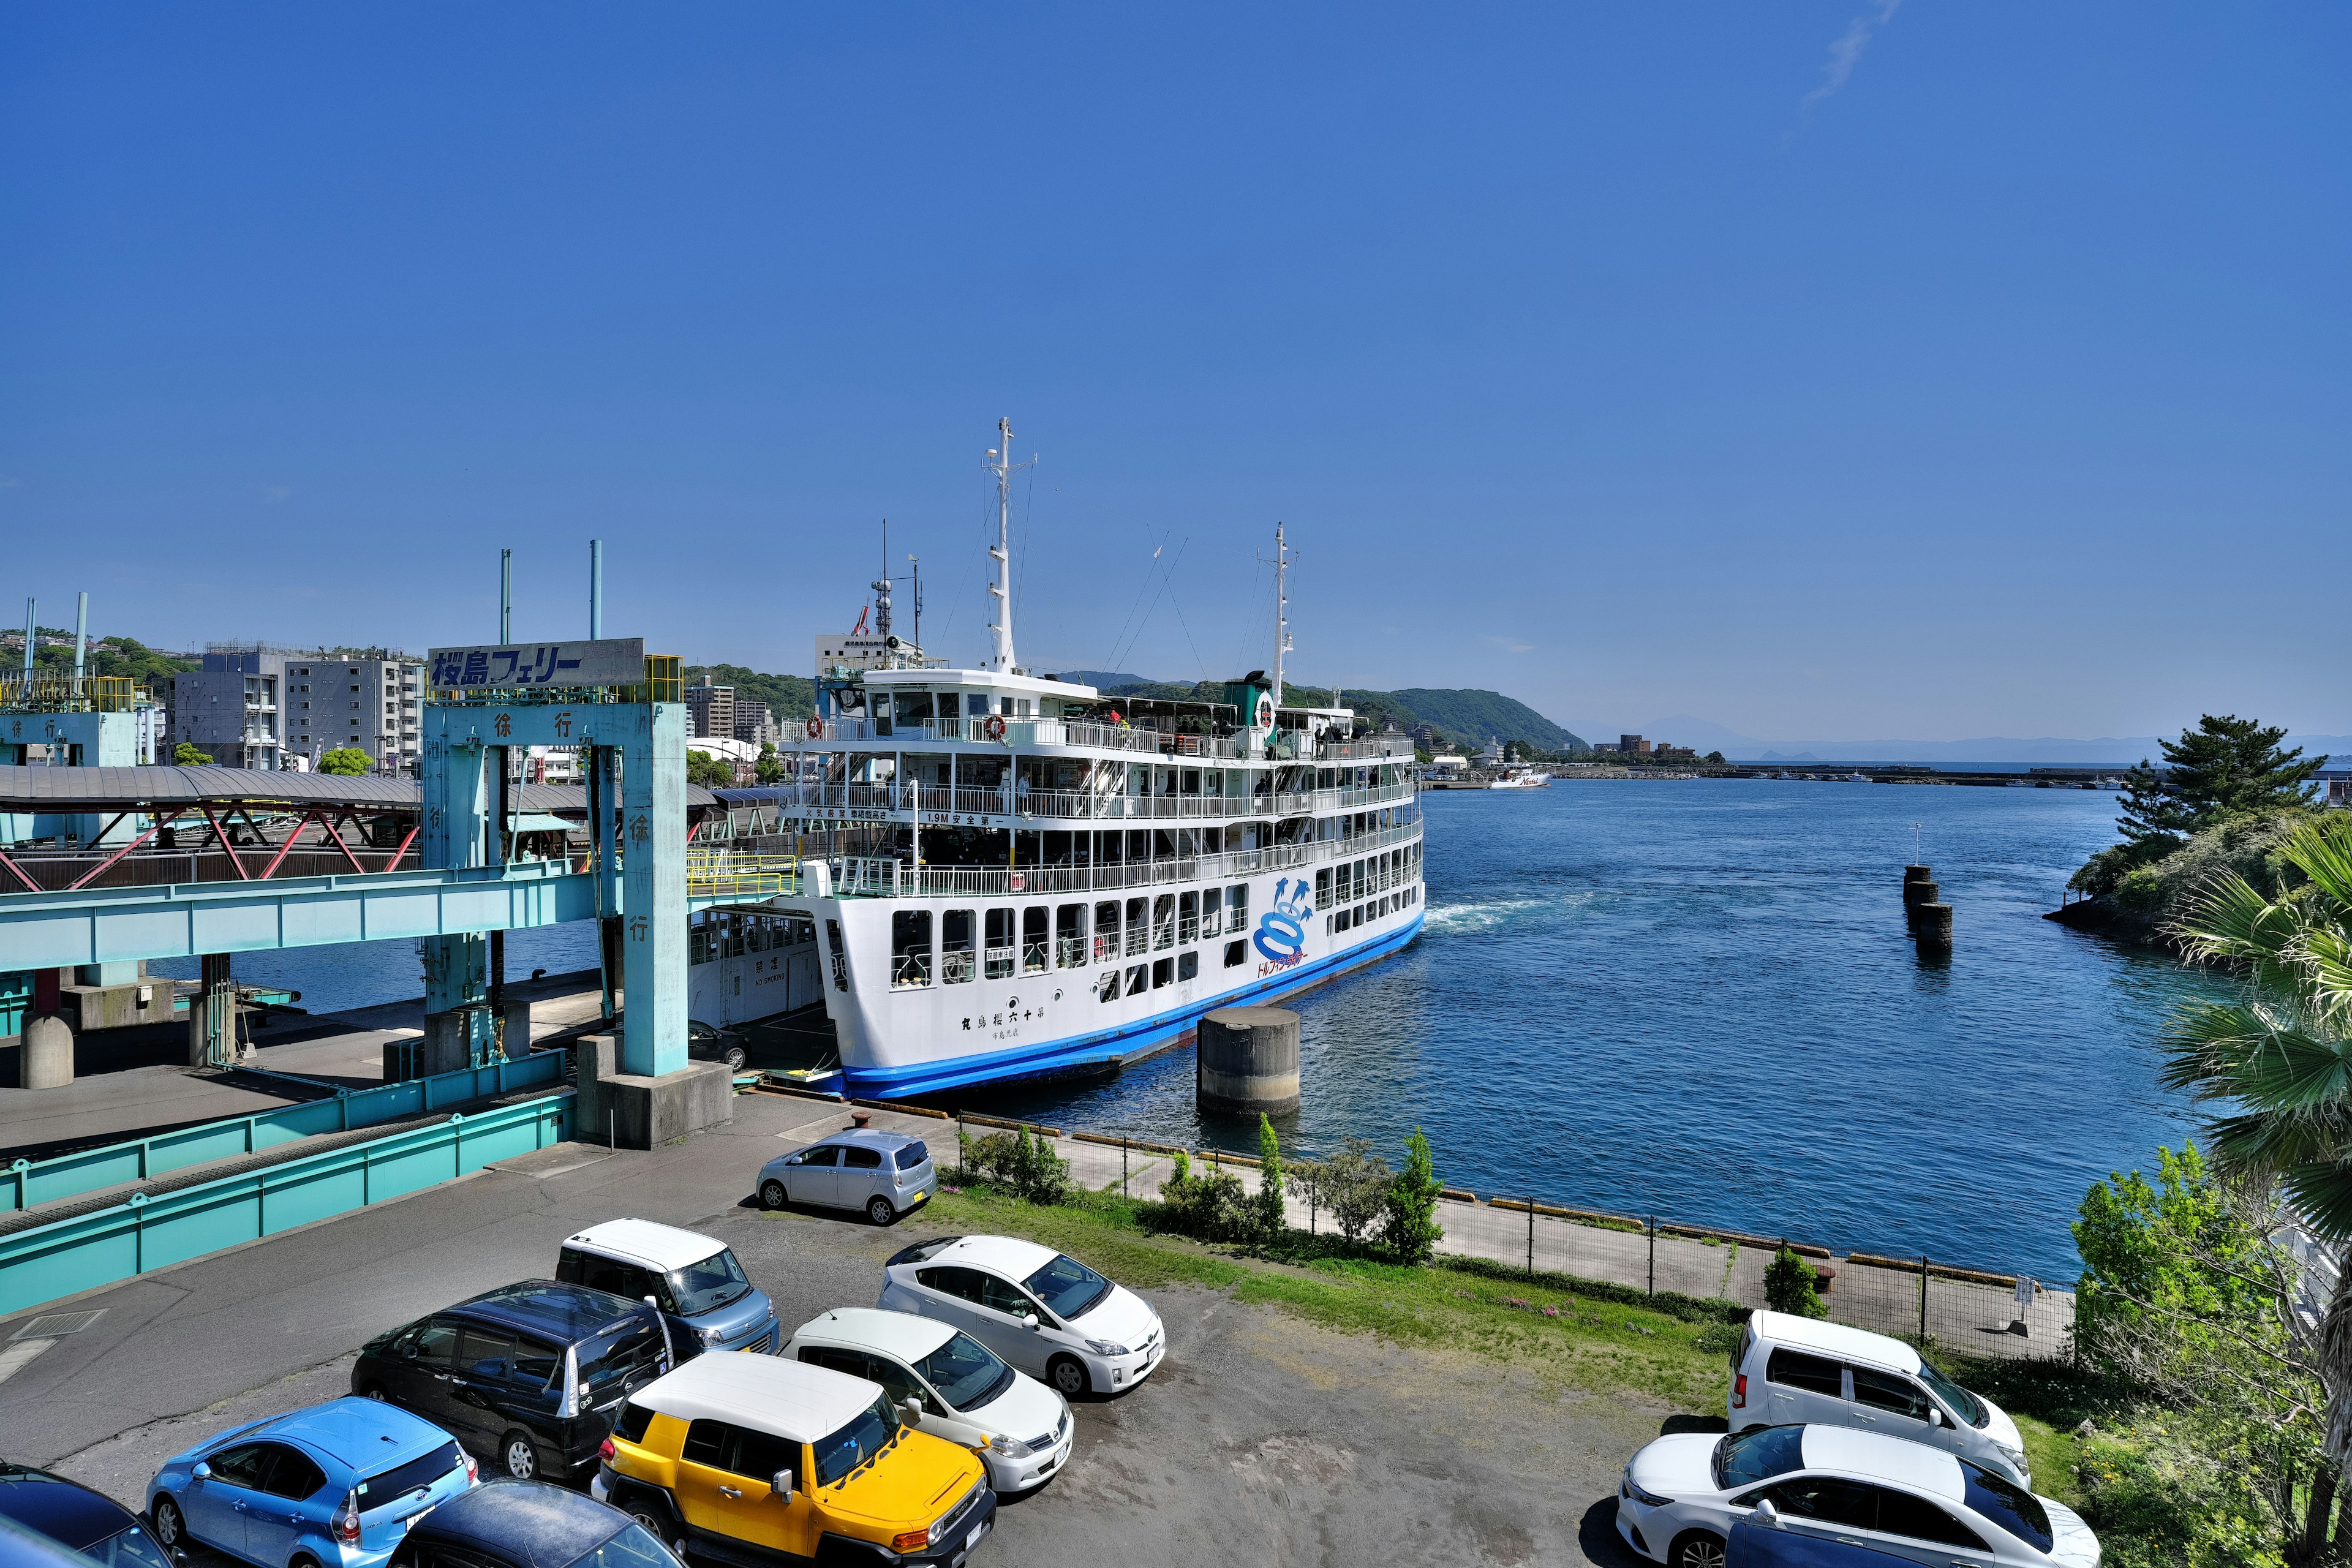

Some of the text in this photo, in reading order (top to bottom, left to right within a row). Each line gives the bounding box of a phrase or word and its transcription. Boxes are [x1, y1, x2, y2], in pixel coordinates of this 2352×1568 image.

[432, 647, 582, 685] 桜島フェリー
[12, 719, 55, 737] 徐行
[494, 712, 571, 737] 徐行
[806, 809, 846, 818] 火気厳禁
[851, 810, 948, 823] 車積載高さ 1.9M
[953, 814, 1004, 826] 安全第一
[629, 814, 648, 942] 徐行
[756, 956, 778, 974] 禁煙
[764, 973, 785, 984] SMOKING
